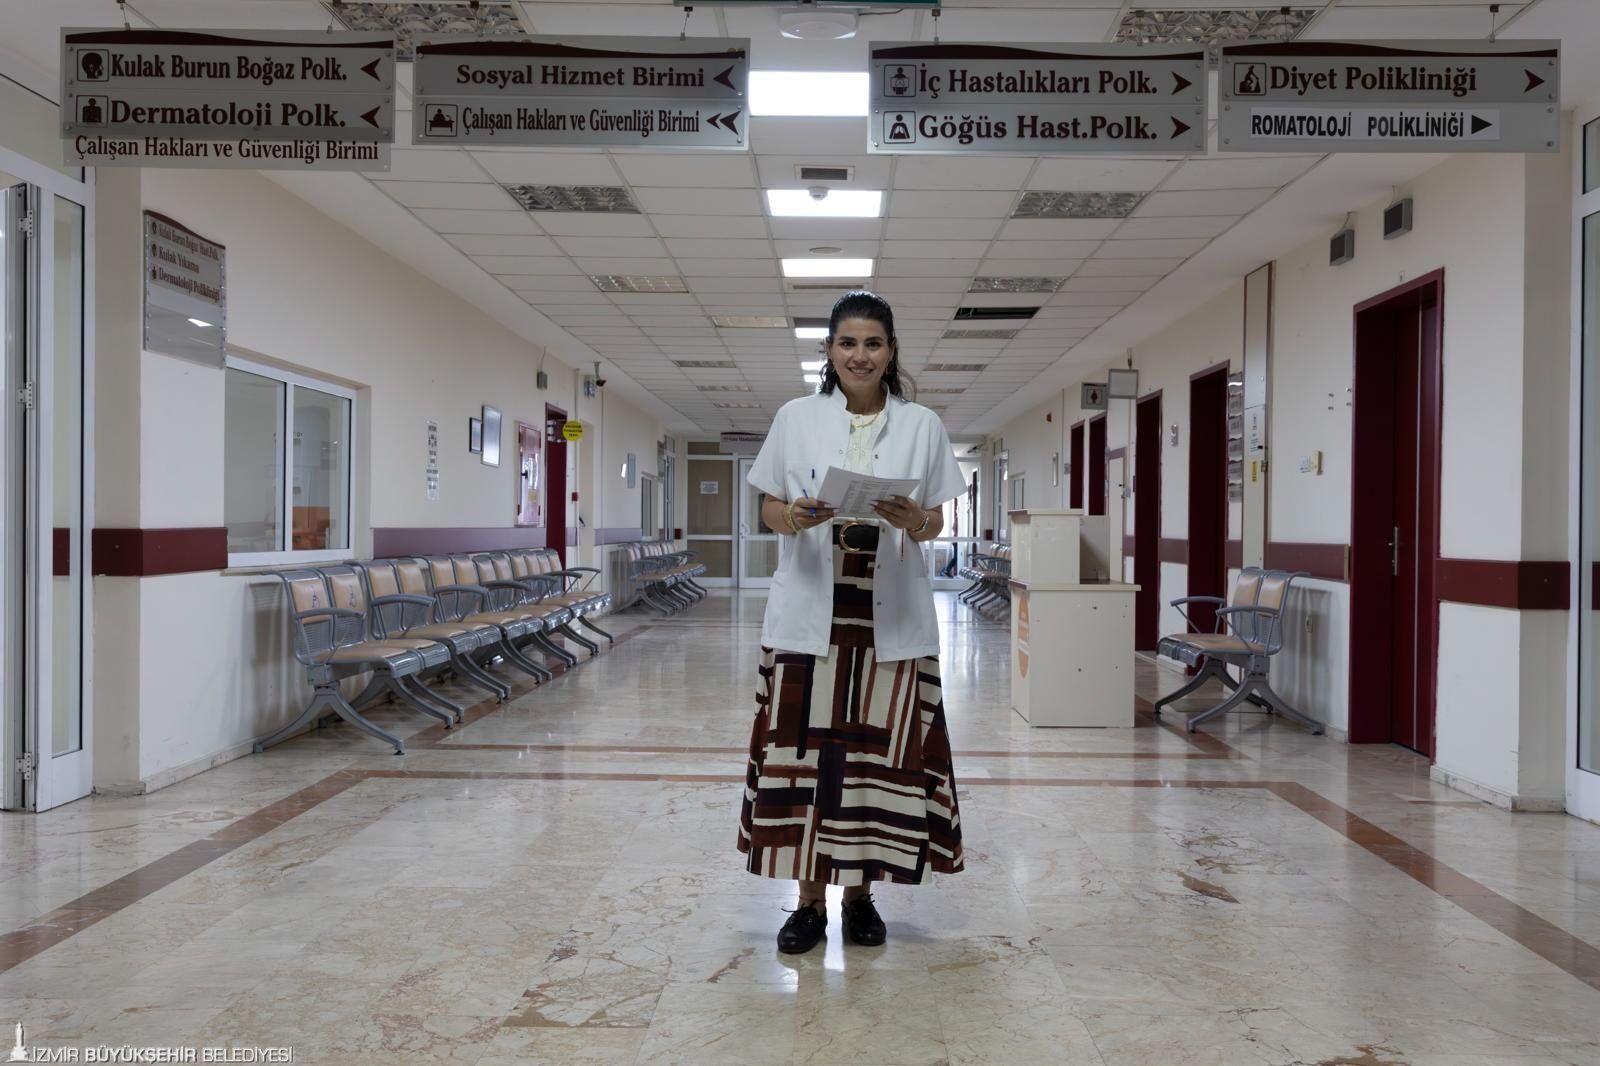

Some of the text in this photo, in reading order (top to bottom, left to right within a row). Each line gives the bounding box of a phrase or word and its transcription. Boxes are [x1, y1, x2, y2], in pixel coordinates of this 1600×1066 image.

[111, 54, 347, 86] Kulak Burun Boğaz Polk.
[457, 65, 704, 89] Sosyal Hizmet Birimi
[919, 64, 1157, 98] İç Hastalıkları Polk.
[1270, 66, 1476, 96] Diyet Polikliniği
[111, 101, 346, 127] Dermatoloji Polk.
[463, 107, 699, 137] Çalışan Hakları ve Güvenliği Birimi
[1252, 112, 1464, 136] ROMATOLOJİ POLİKLİNİĞİ
[919, 115, 1157, 144] Göğüs Hast.Polk.
[76, 136, 378, 164] Çalışan Hakları ve Güvenliği Birimi
[159, 246, 176, 264] Kulak
